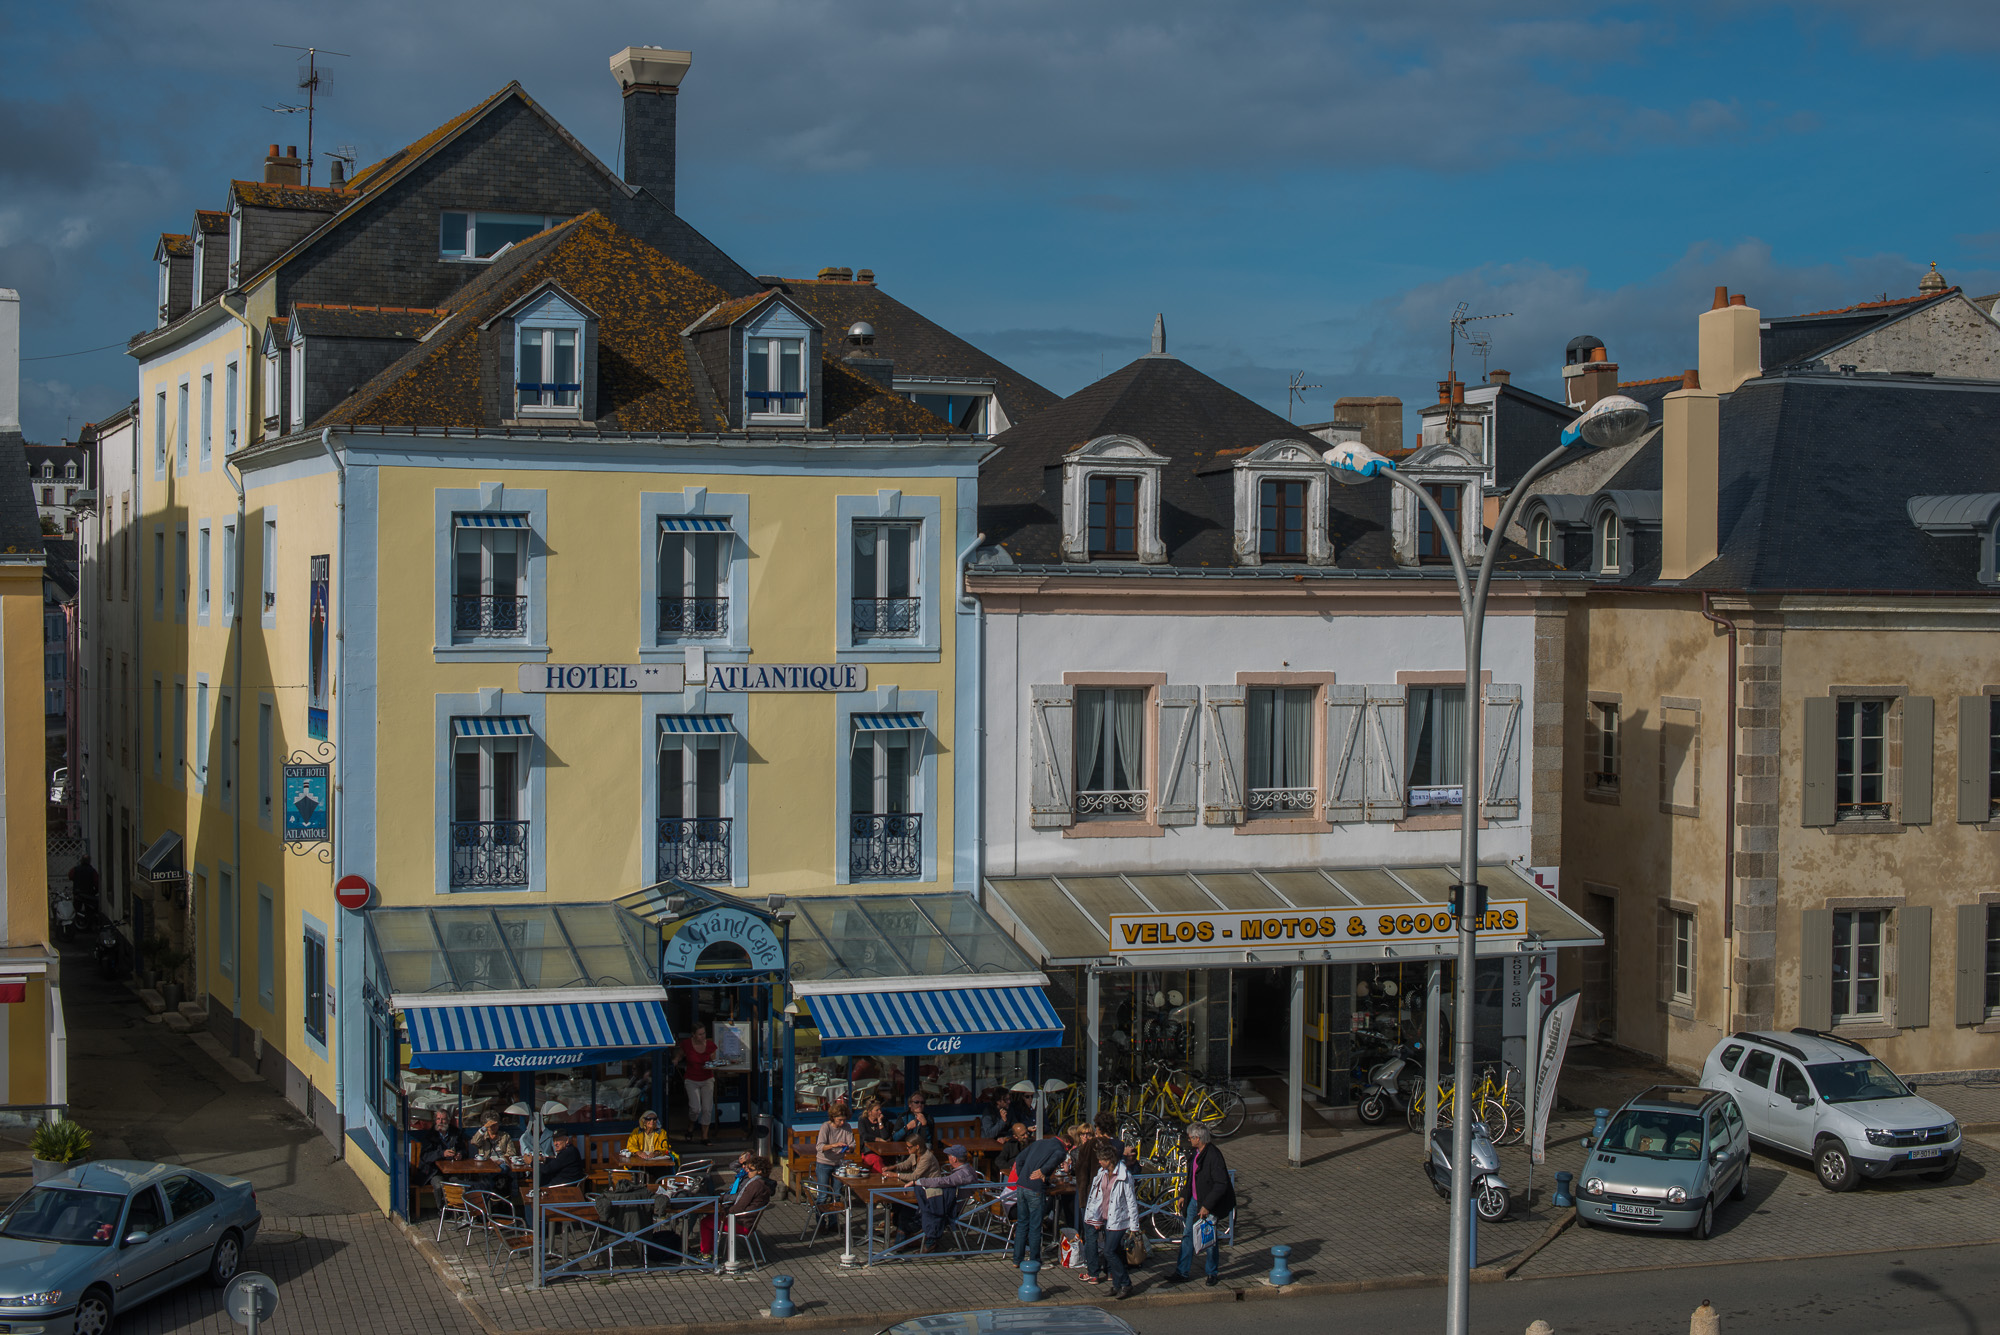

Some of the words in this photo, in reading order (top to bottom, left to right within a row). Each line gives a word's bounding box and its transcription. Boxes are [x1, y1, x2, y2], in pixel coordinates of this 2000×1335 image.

[311, 558, 328, 581] HOTEL
[546, 665, 637, 689] HOTEL
[710, 665, 857, 691] ATLANTIQUE
[286, 828, 327, 839] ATLANTIQUE
[152, 870, 182, 880] HOTEL
[1120, 921, 1214, 944] VELOS
[1240, 916, 1336, 941] MOTOS
[1347, 916, 1367, 936] &
[666, 942, 692, 970] Le
[687, 912, 749, 949] Grand
[747, 924, 777, 966] Café
[926, 1036, 961, 1054] Café
[492, 1051, 585, 1067] Restaurant
